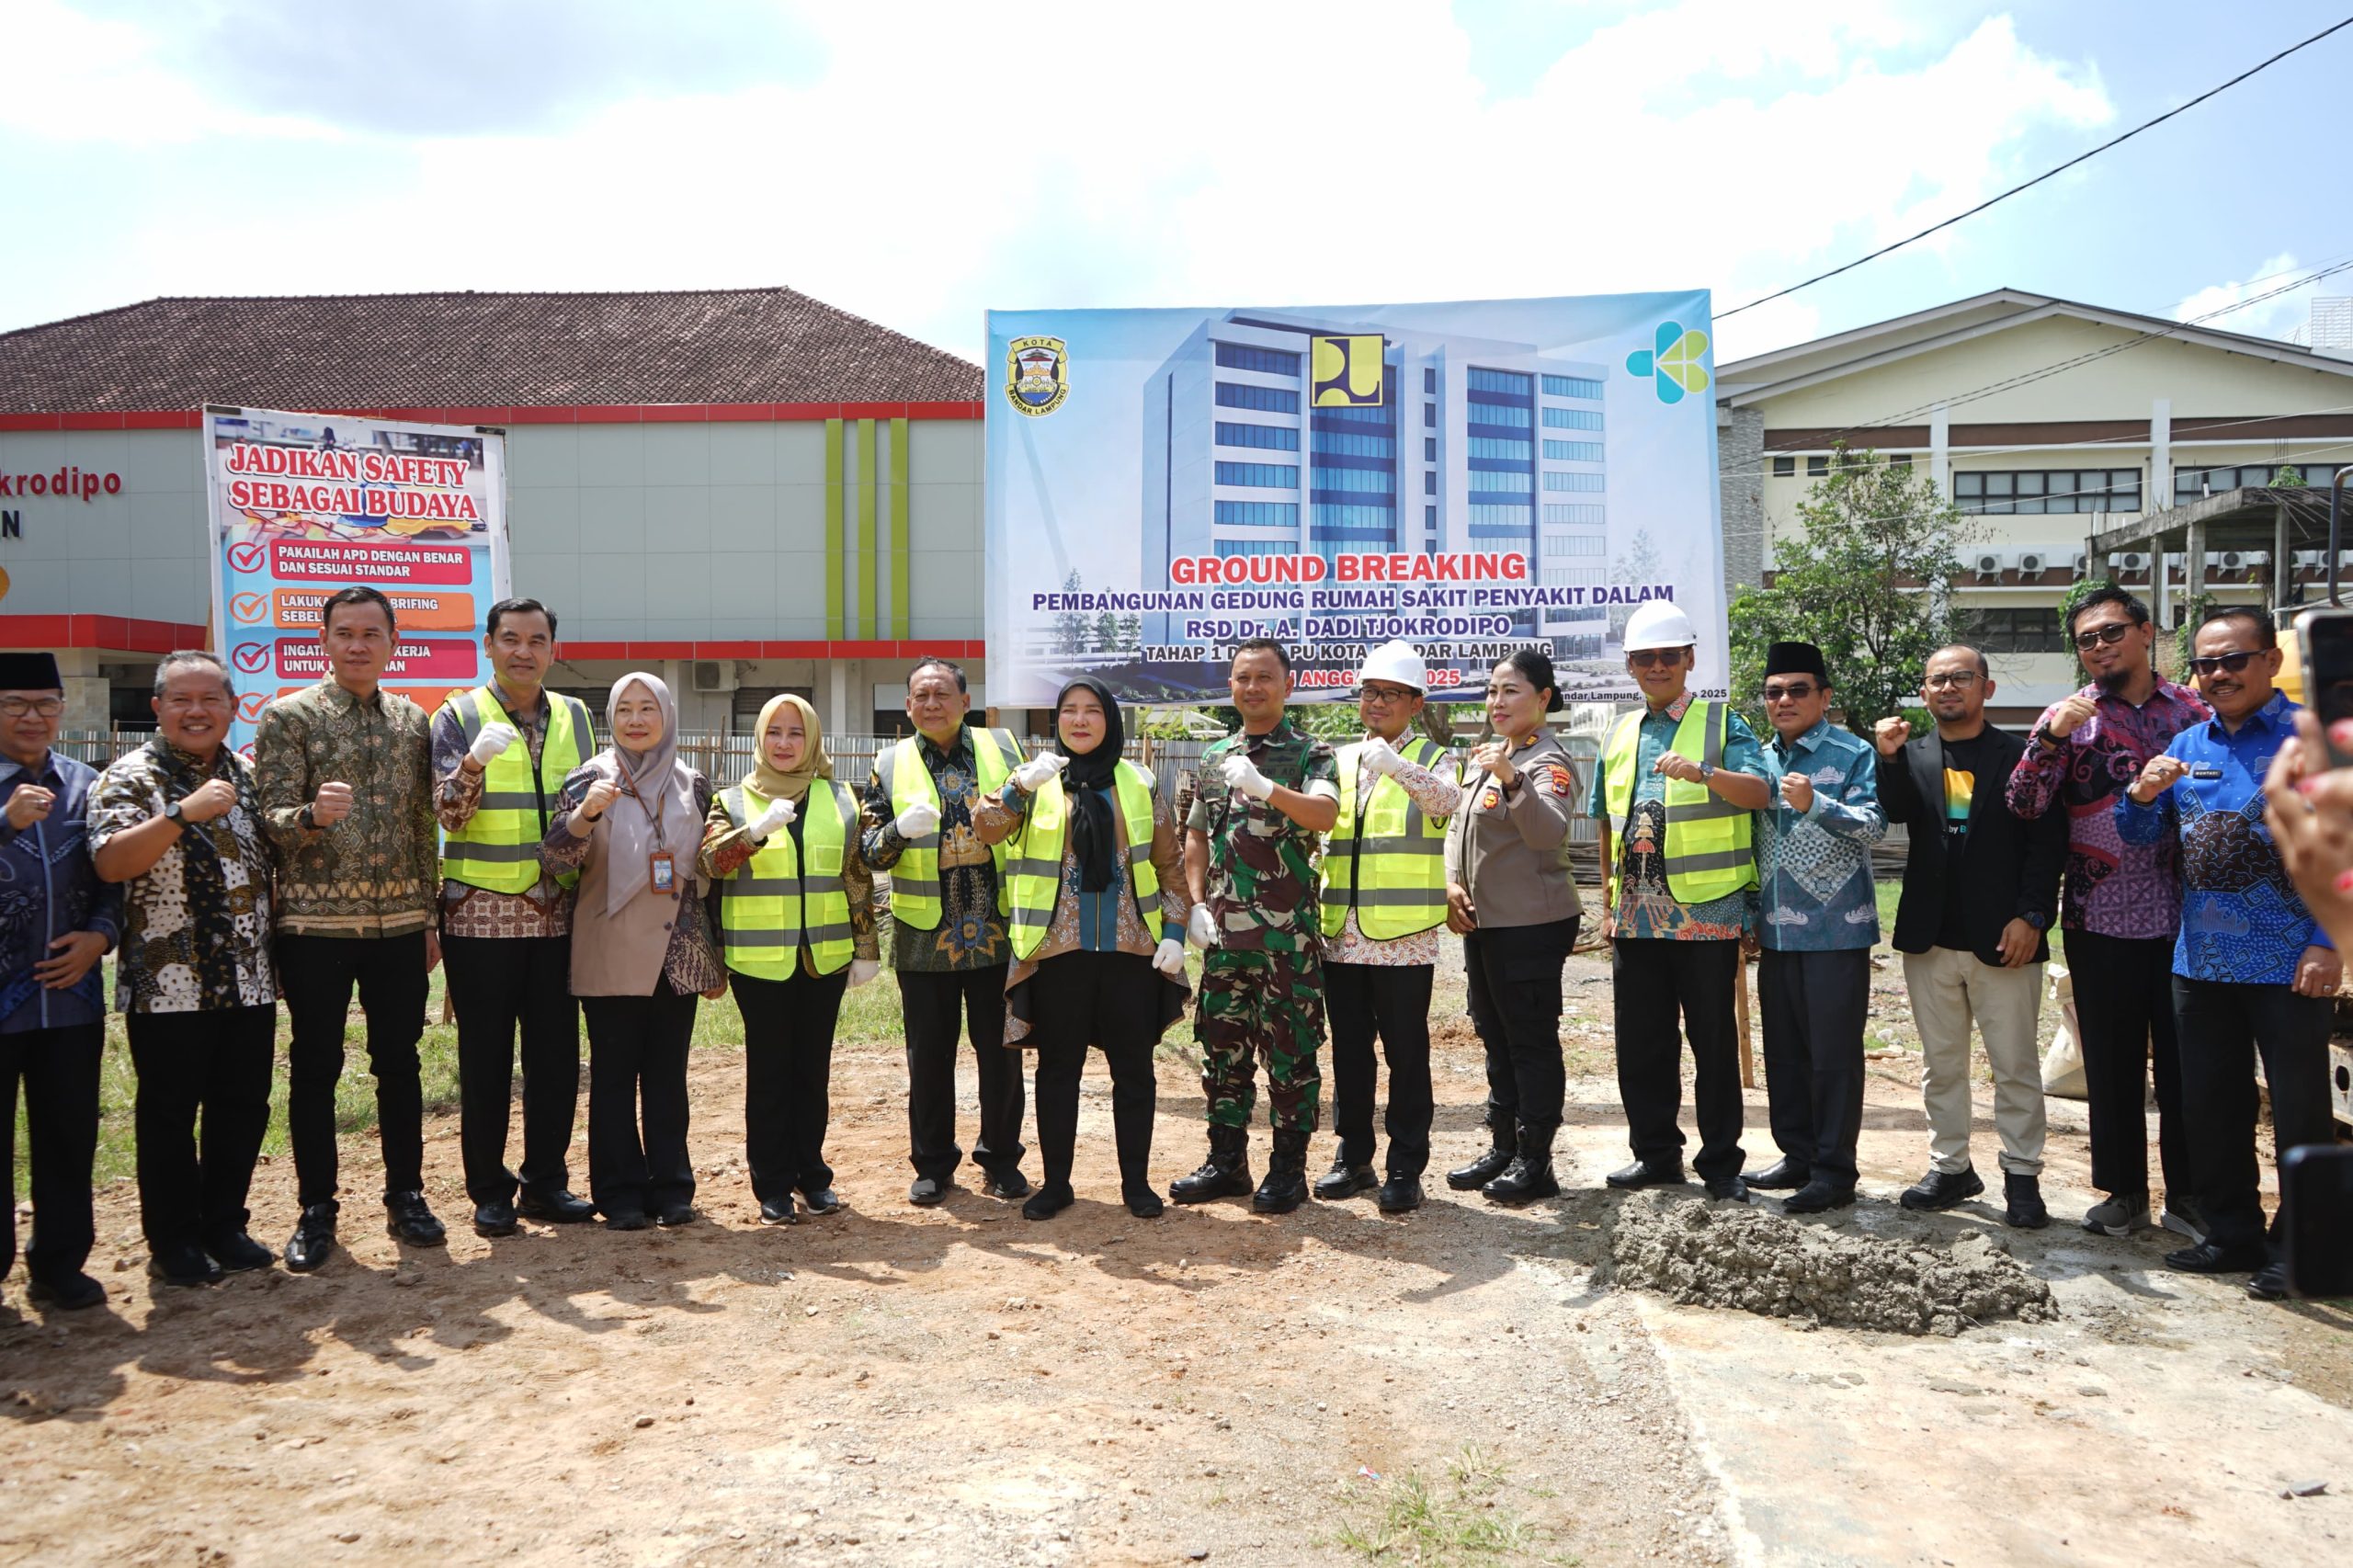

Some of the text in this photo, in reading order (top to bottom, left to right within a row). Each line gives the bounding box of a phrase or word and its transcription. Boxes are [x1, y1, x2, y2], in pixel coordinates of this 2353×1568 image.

[1008, 389, 1066, 415] BANDAR LAMPUNG
[229, 445, 468, 485] JADIKAN SAFETY
[231, 481, 478, 518] SEBAGAI BUDAYA
[278, 546, 463, 563] PAKAILAH APD DENGAN BENAR
[278, 562, 410, 577] DAN SESUAI STANDAR
[1171, 553, 1526, 584] GROUND BREAKING
[280, 595, 438, 610] LAKUKA BRIFING
[1033, 585, 1674, 610] PEMBANGUNAN GEDUNG RUMAH SAKIT PENYAKIT DALAM
[281, 610, 324, 622] SEBEL
[1187, 617, 1510, 638] RSD Dr. A. DADI TJOKRODIPO
[1146, 646, 1206, 661] TAHAP
[1211, 646, 1222, 660] 1
[1290, 645, 1314, 660] PU
[1320, 644, 1368, 659] KOTA
[284, 660, 326, 672] UNTUK
[1427, 670, 1461, 685] 025
[1563, 691, 1588, 700] ndar
[1591, 691, 1643, 701] Lampung,
[1700, 689, 1727, 699] 2025
